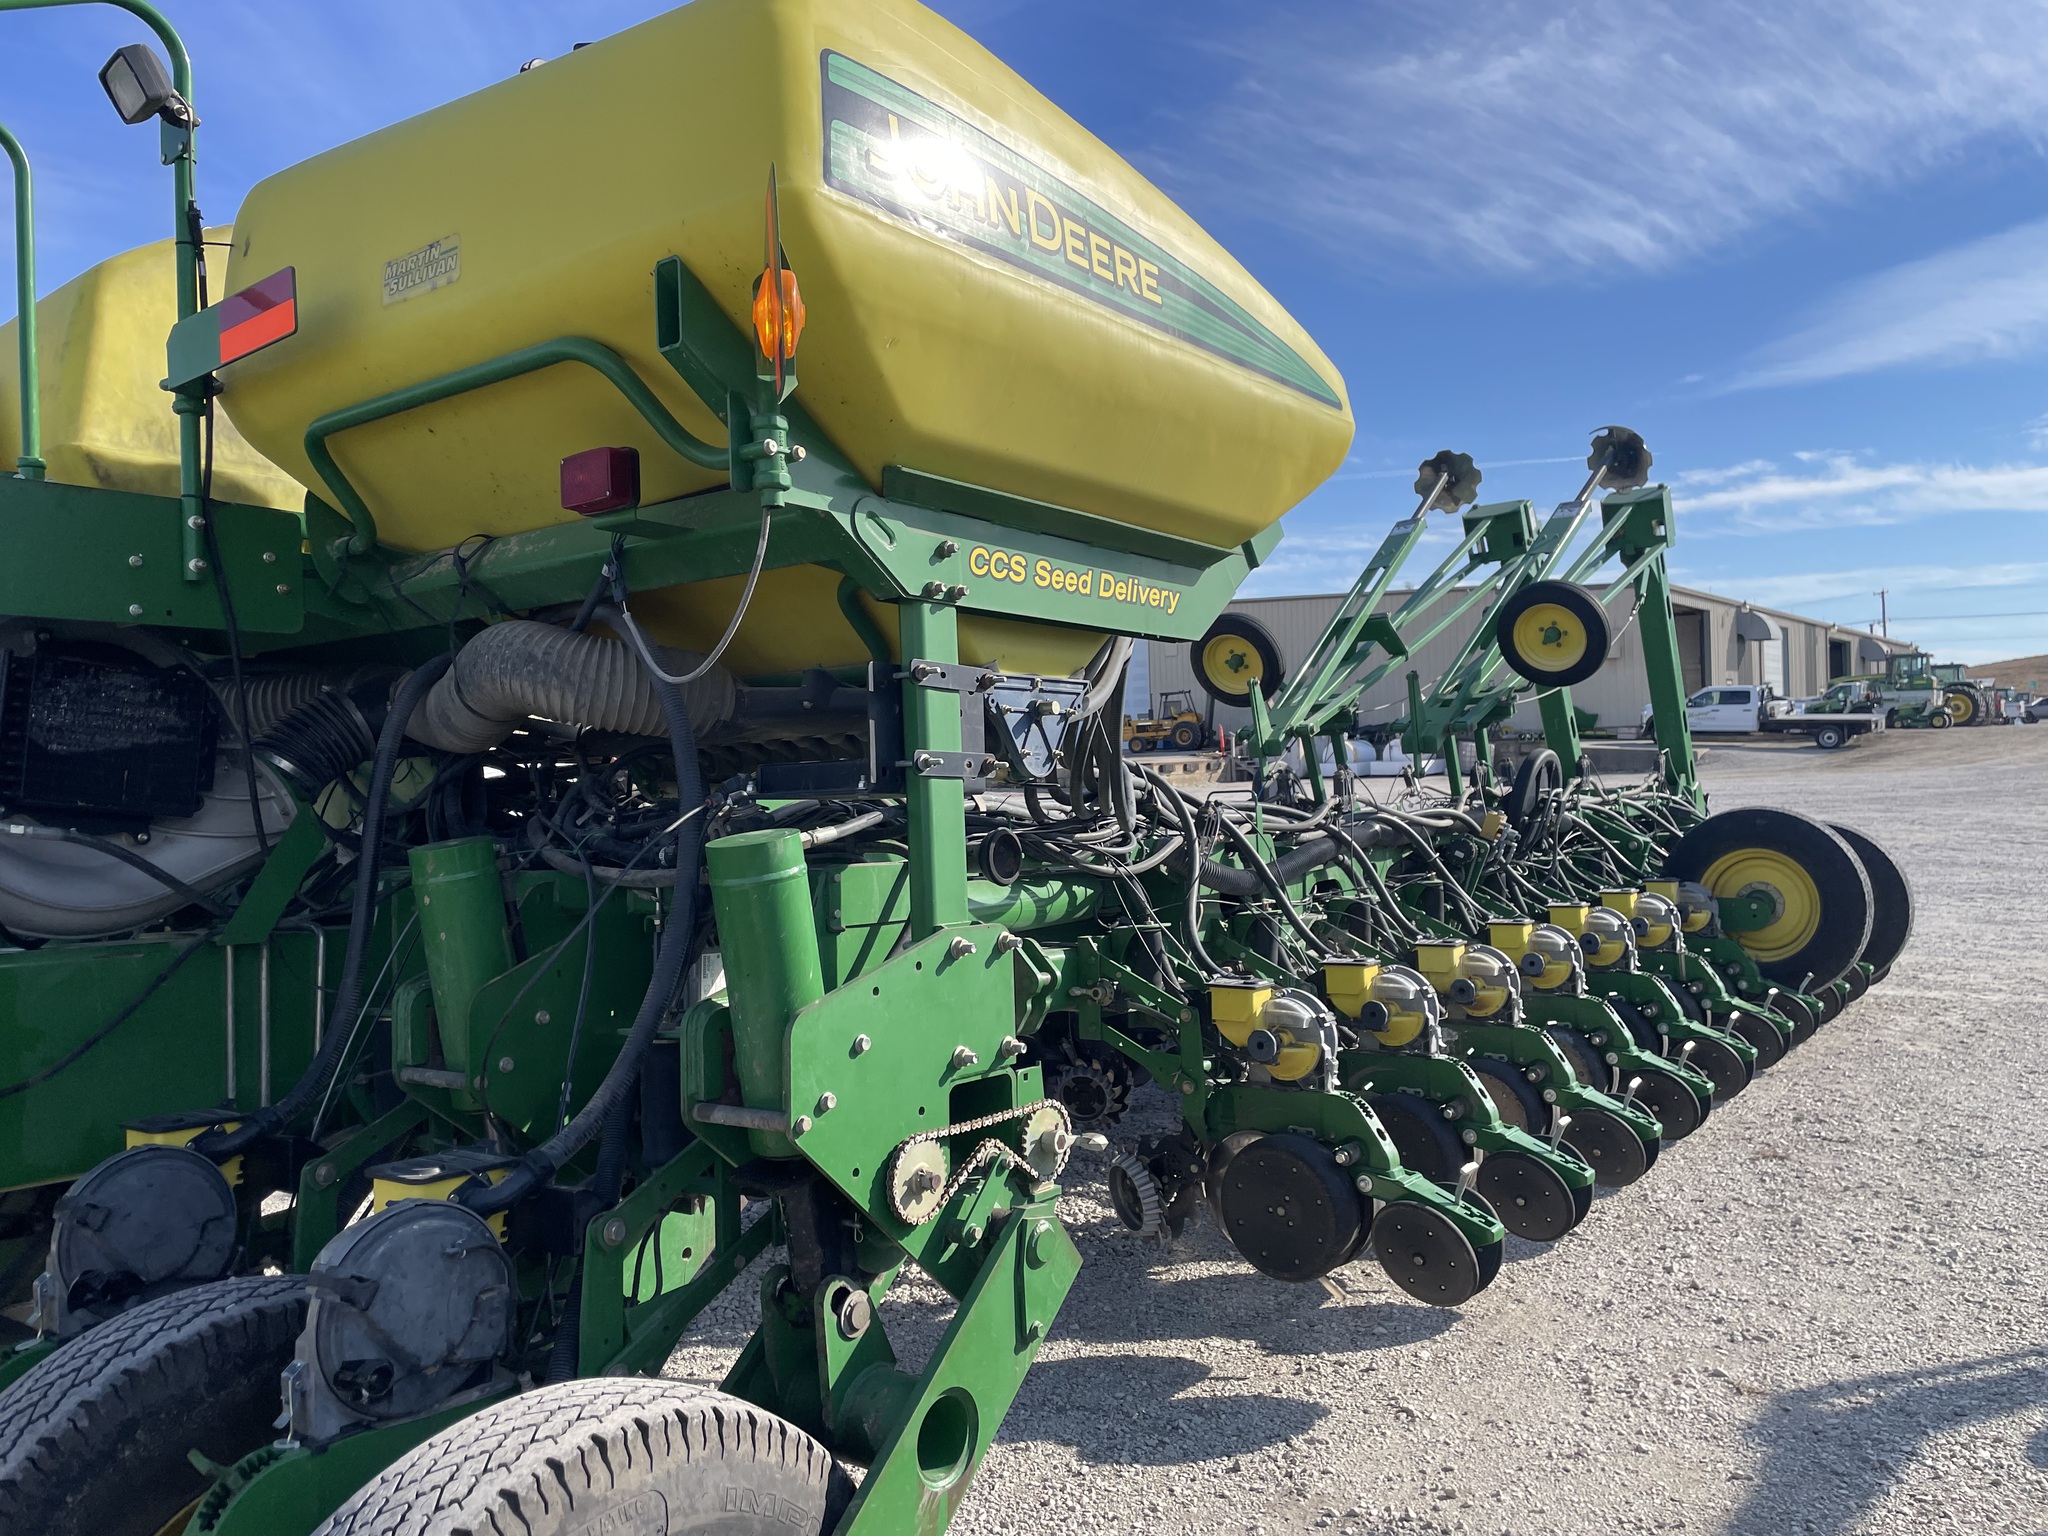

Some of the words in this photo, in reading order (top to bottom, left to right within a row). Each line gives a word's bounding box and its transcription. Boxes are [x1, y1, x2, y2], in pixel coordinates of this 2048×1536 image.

[384, 243, 441, 281] MARTIN
[1026, 187, 1163, 305] DEERE
[389, 253, 458, 296] SULLIVAN
[969, 546, 1027, 584] CCS
[1034, 559, 1093, 596] Seed
[1098, 572, 1181, 614] Delivery
